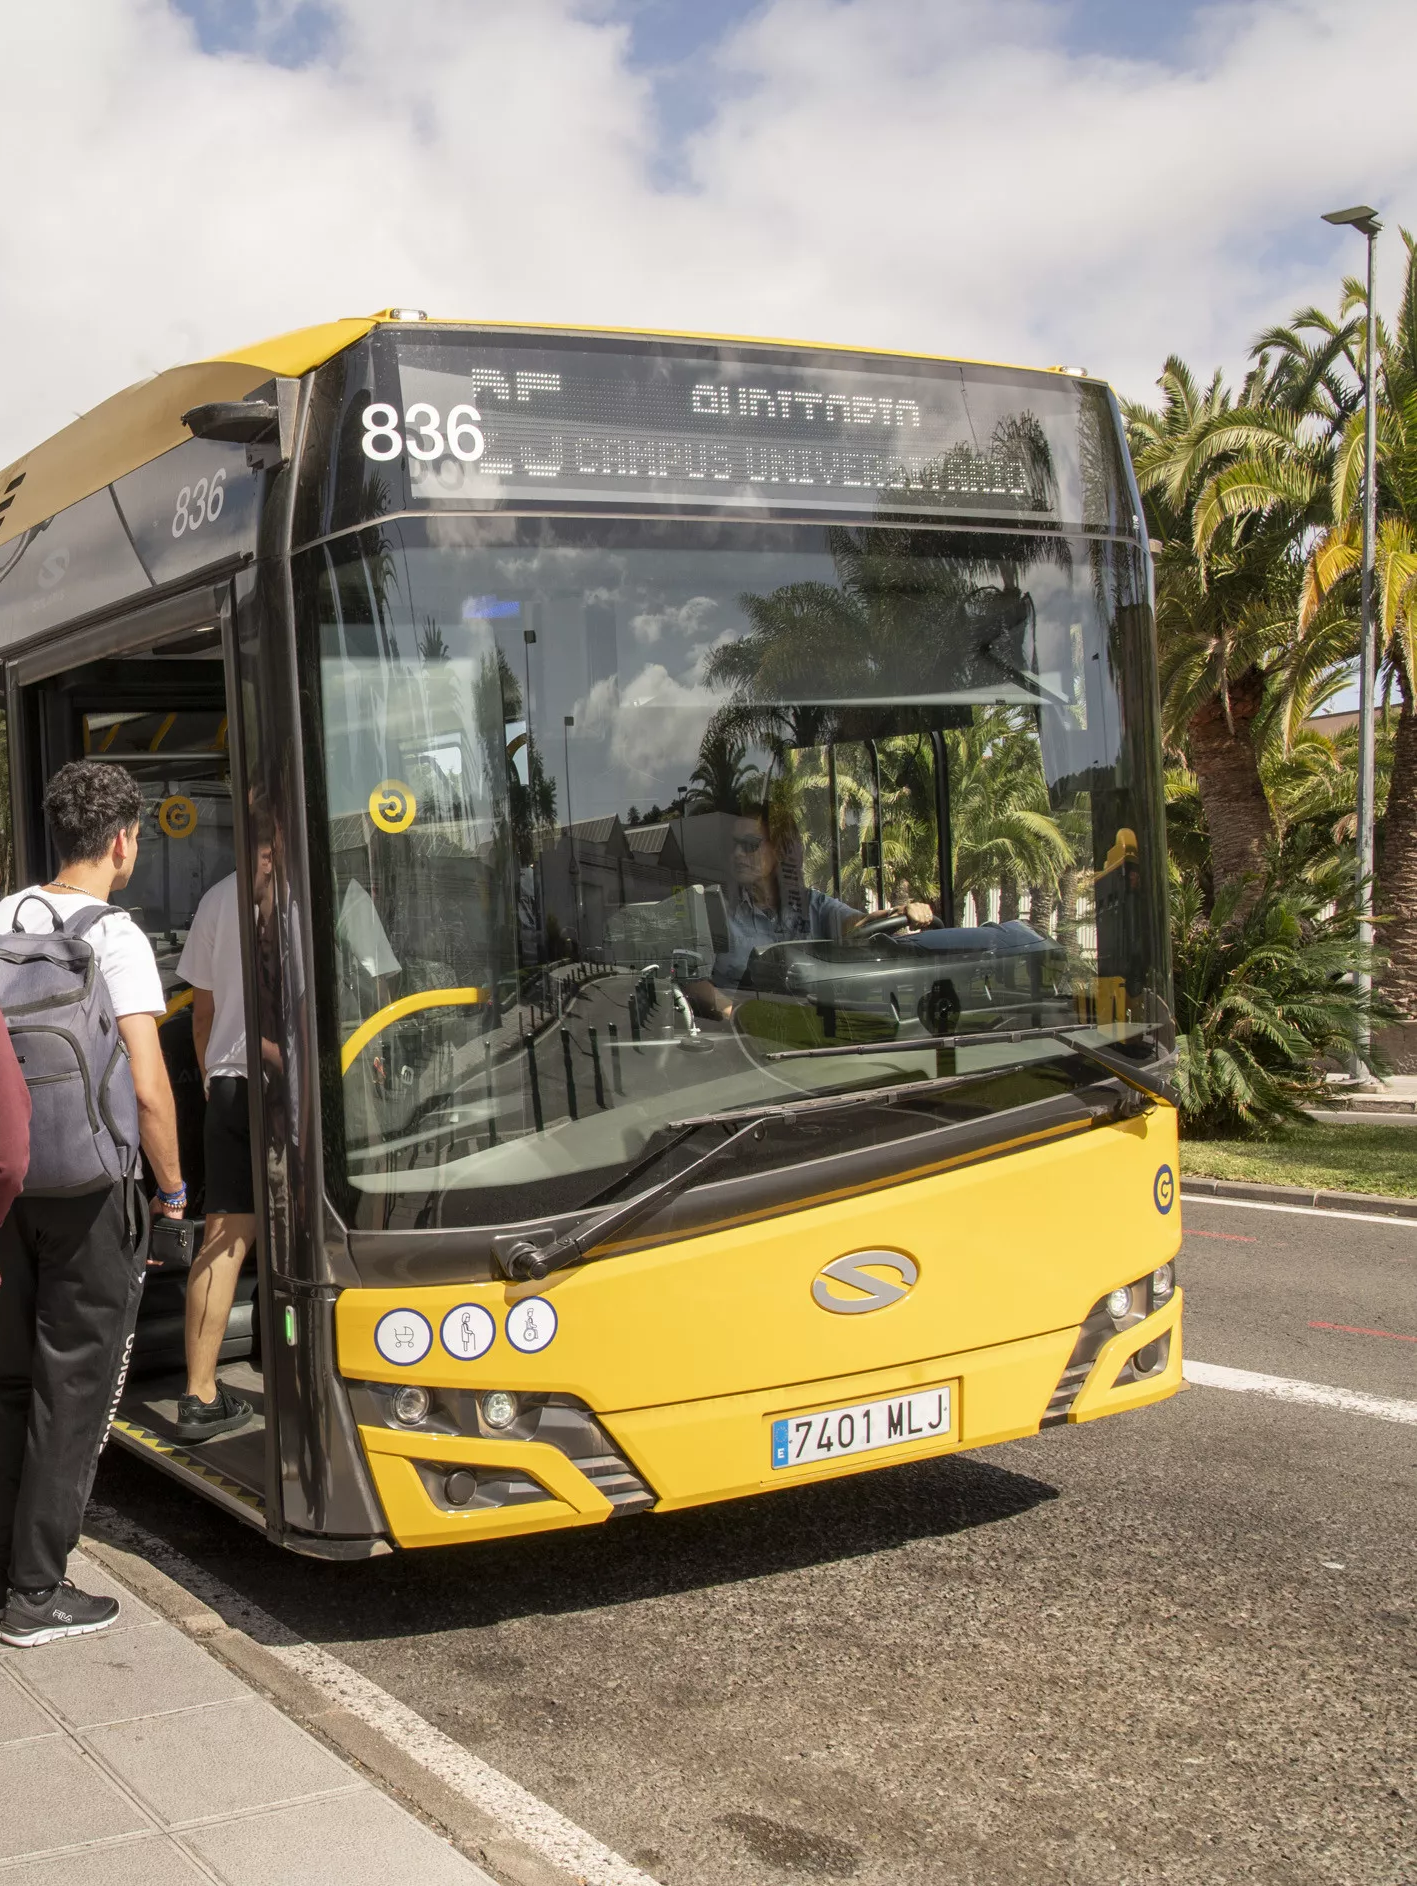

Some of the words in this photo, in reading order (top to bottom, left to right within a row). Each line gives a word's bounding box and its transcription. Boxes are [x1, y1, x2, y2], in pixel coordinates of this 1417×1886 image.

[361, 402, 485, 462] 836
[575, 436, 732, 479] CAMPUS
[171, 467, 227, 539] 836
[795, 1410, 871, 1458] 7401
[887, 1394, 943, 1439] MLJ
[777, 1447, 785, 1459] E
[52, 1609, 73, 1623] FILA
